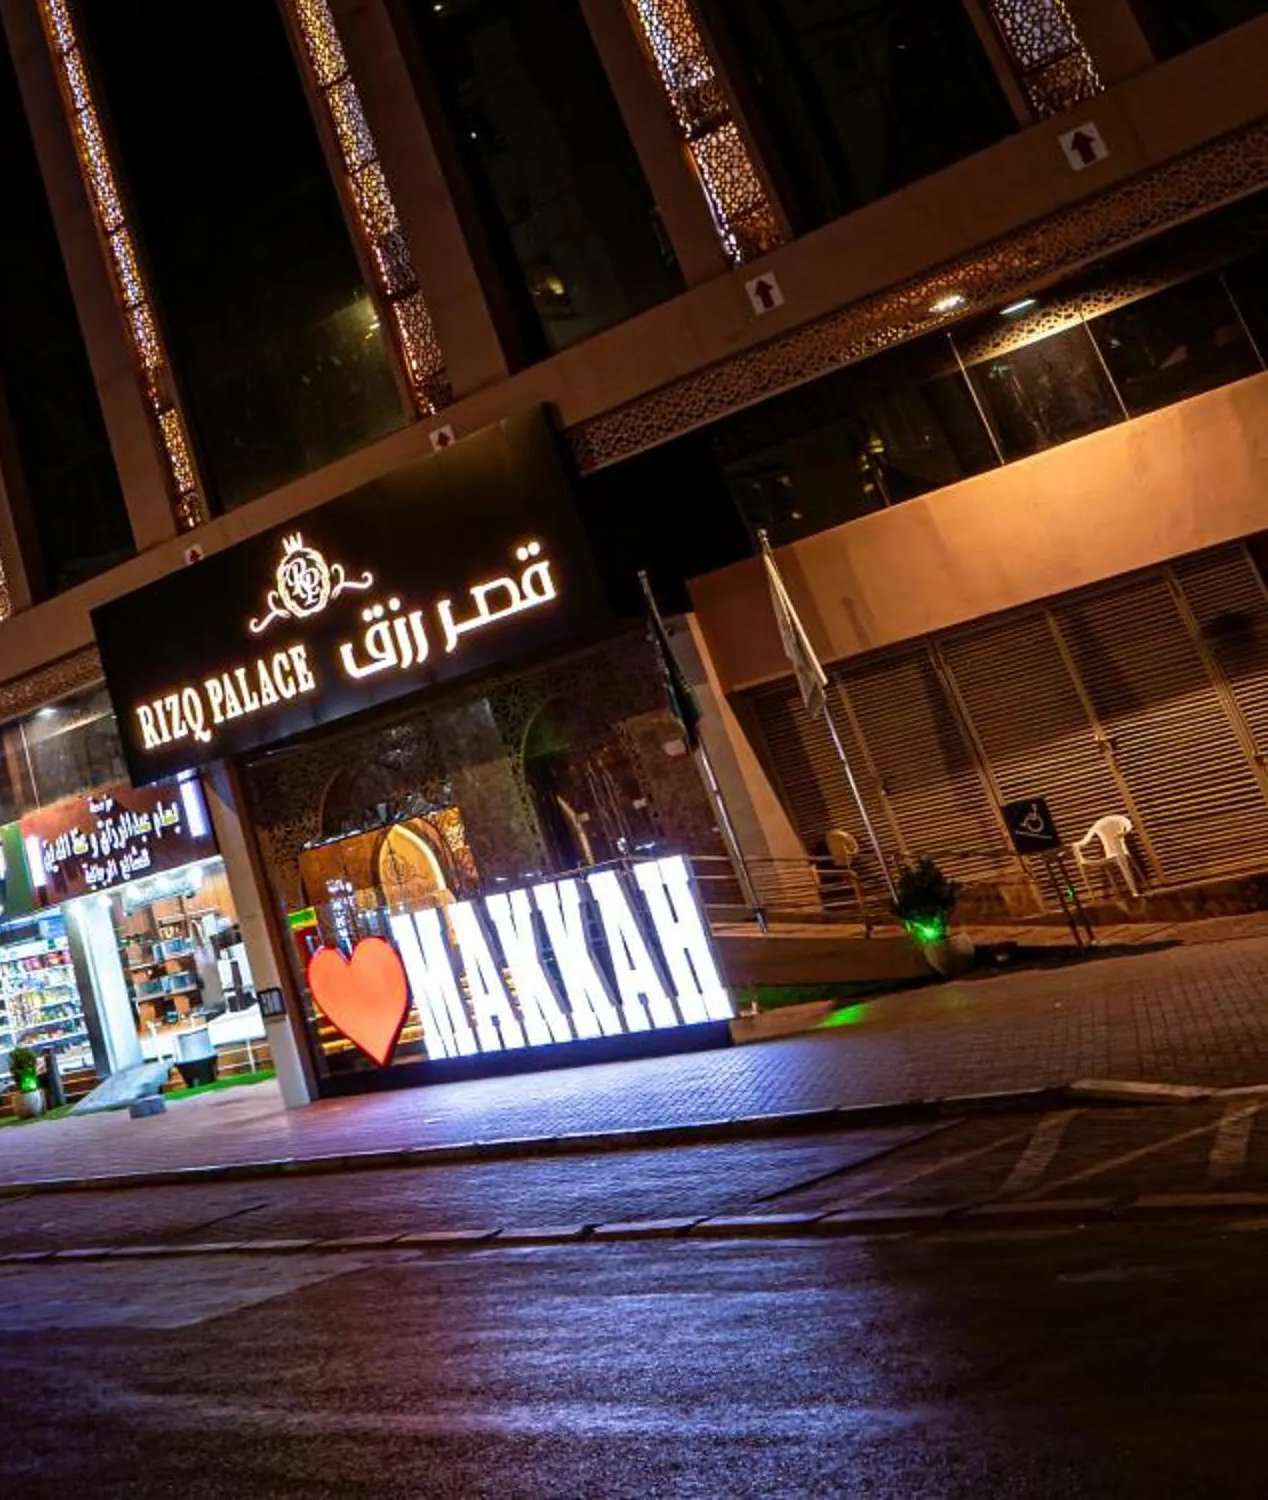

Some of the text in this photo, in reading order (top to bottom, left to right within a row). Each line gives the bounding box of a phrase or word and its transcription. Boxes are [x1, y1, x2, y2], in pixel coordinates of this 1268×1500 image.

[339, 541, 557, 679] قصر رزق
[136, 644, 316, 750] RIZQ PALACE
[390, 854, 735, 1061] MAKKAH
